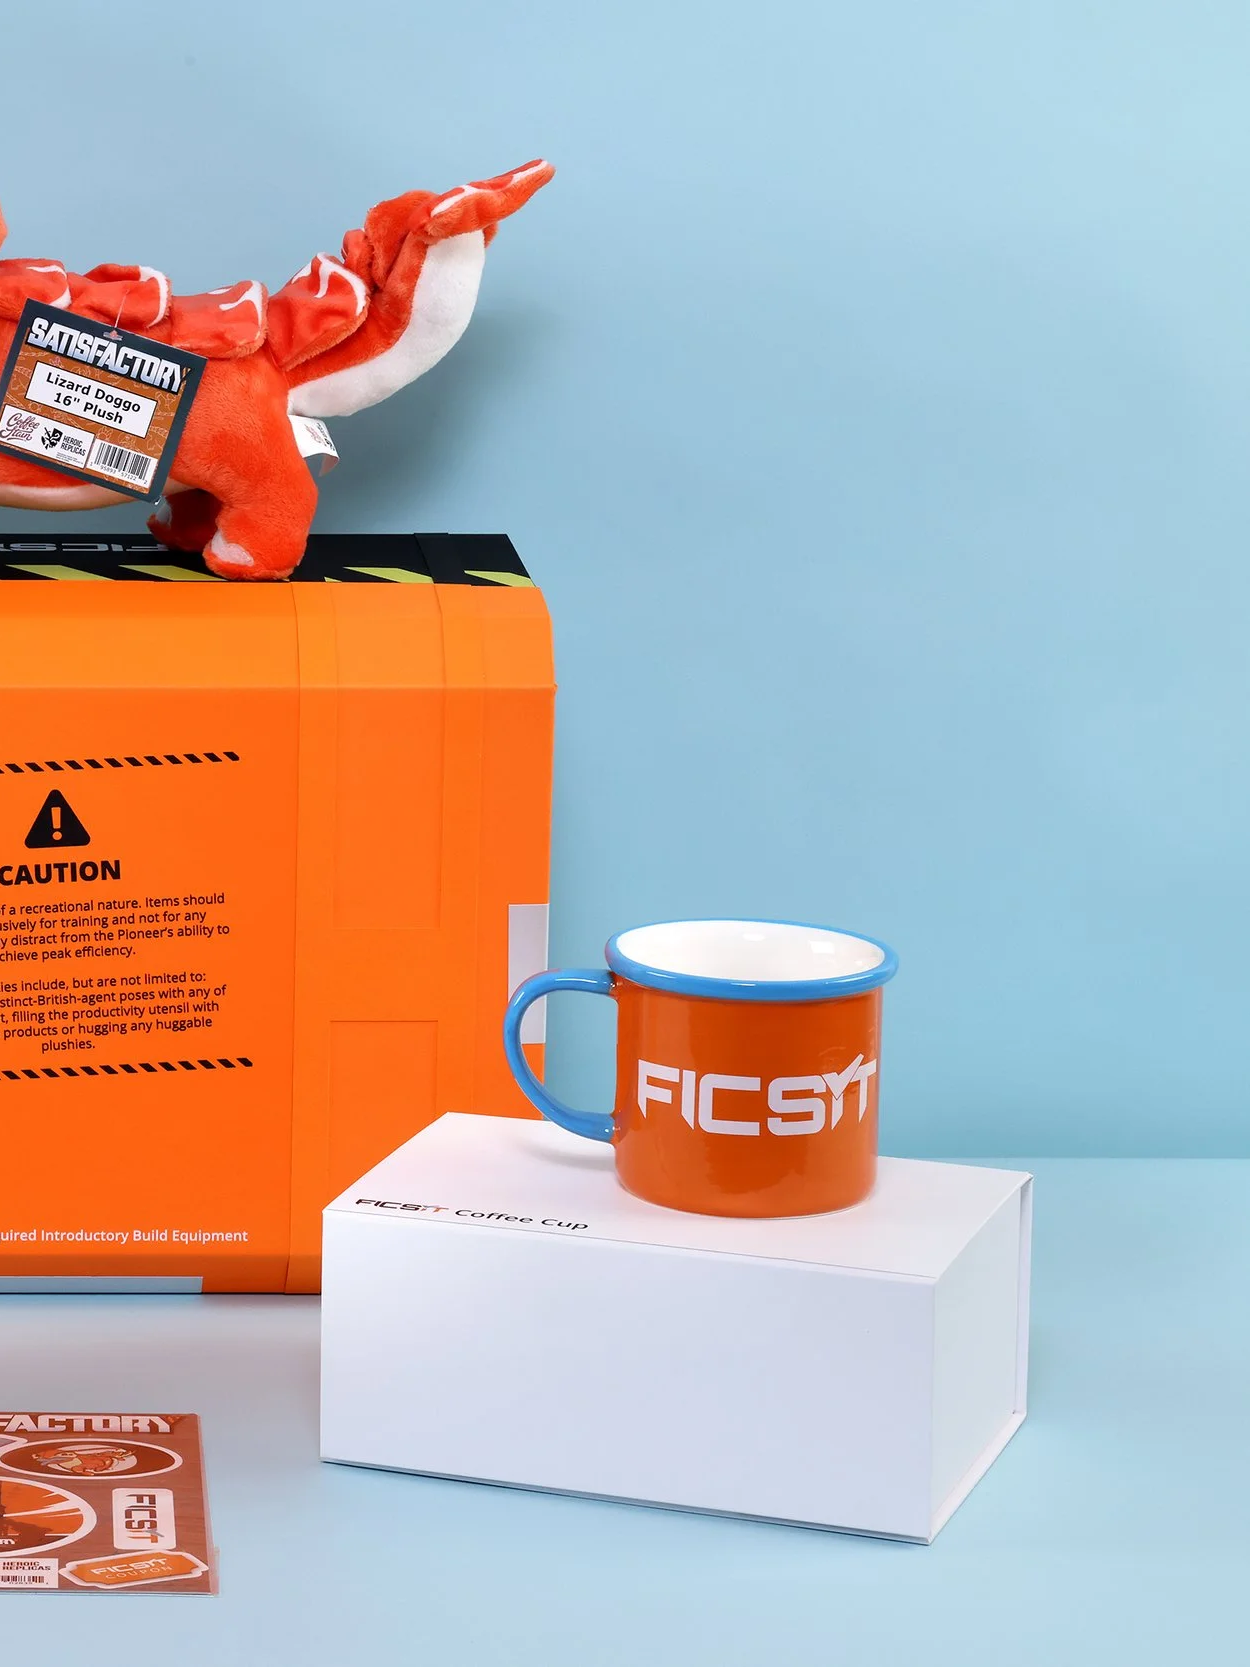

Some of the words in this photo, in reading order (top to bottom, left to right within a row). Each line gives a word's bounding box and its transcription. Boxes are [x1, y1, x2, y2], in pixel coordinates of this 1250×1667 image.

[28, 317, 189, 393] SATISFACTORY
[46, 372, 90, 395] Lizard
[94, 388, 141, 413] Doggo
[54, 392, 80, 407] 16"
[83, 402, 123, 424] Plush
[7, 413, 40, 430] Coffee
[0, 426, 33, 441] Stain
[62, 435, 83, 447] HEROIC
[61, 443, 86, 457] REPLICAS
[9, 906, 16, 916] a
[20, 900, 94, 914] recreational
[98, 900, 142, 910] nature.
[146, 897, 180, 908] Items
[183, 892, 224, 906] should
[39, 917, 58, 929] for
[60, 916, 109, 929] training
[112, 913, 135, 925] and
[139, 913, 160, 923] not
[162, 910, 180, 922] for
[184, 912, 206, 923] any
[11, 934, 58, 946] distract
[60, 932, 90, 943] from
[94, 930, 114, 941] the
[177, 925, 214, 938] ability
[217, 925, 230, 934] to
[42, 947, 72, 962] peak
[75, 946, 136, 958] efficiency.
[21, 979, 68, 991] include,
[72, 978, 94, 988] but
[97, 978, 117, 988] are
[120, 976, 141, 986] not
[145, 972, 186, 984] limited
[190, 972, 206, 982] to:
[119, 991, 155, 1004] poses
[158, 987, 184, 999] with
[188, 988, 210, 1000] any
[214, 984, 226, 996] of
[12, 1011, 46, 1024] filling
[48, 1009, 68, 1020] the
[72, 1006, 145, 1022] productivity
[149, 1002, 189, 1015] utensil
[192, 1000, 219, 1012] with
[4, 1026, 58, 1040] products
[62, 1026, 75, 1035] or
[78, 1022, 127, 1036] hugging
[130, 1022, 153, 1033] any
[156, 1016, 212, 1032] huggable
[42, 1039, 95, 1053] plushies.
[455, 1210, 533, 1223] Coffee
[542, 1219, 588, 1230] Cup
[41, 1229, 129, 1244] Introductory
[133, 1229, 168, 1241] Build
[172, 1230, 248, 1244] Equipment
[105, 1566, 172, 1579] COUPON
